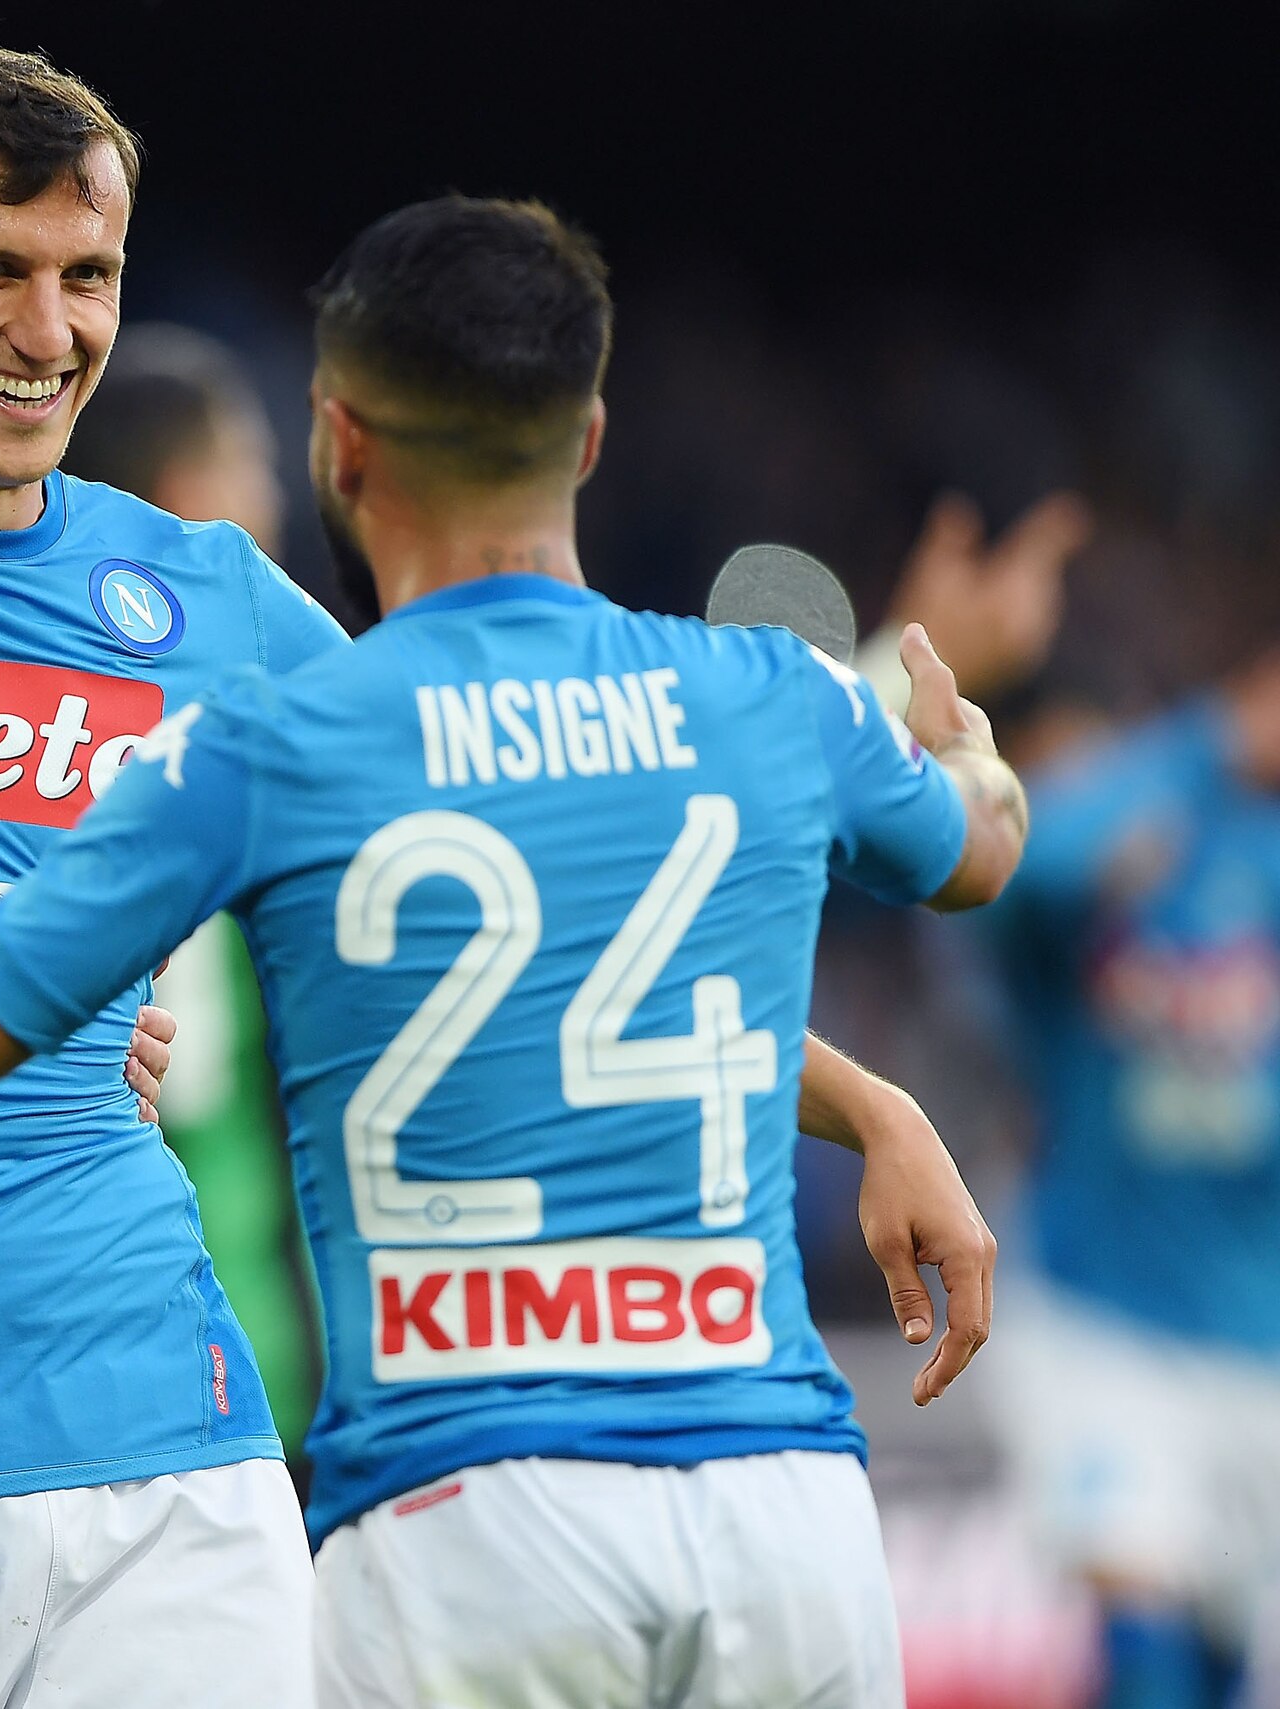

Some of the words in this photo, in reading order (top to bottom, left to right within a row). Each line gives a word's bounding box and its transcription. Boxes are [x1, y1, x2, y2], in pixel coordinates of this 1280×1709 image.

[111, 582, 157, 631] N
[415, 667, 698, 788] INSIGNE
[335, 794, 778, 1244] 24
[379, 1264, 756, 1356] KIMBO
[210, 1347, 227, 1411] KOMBAT
